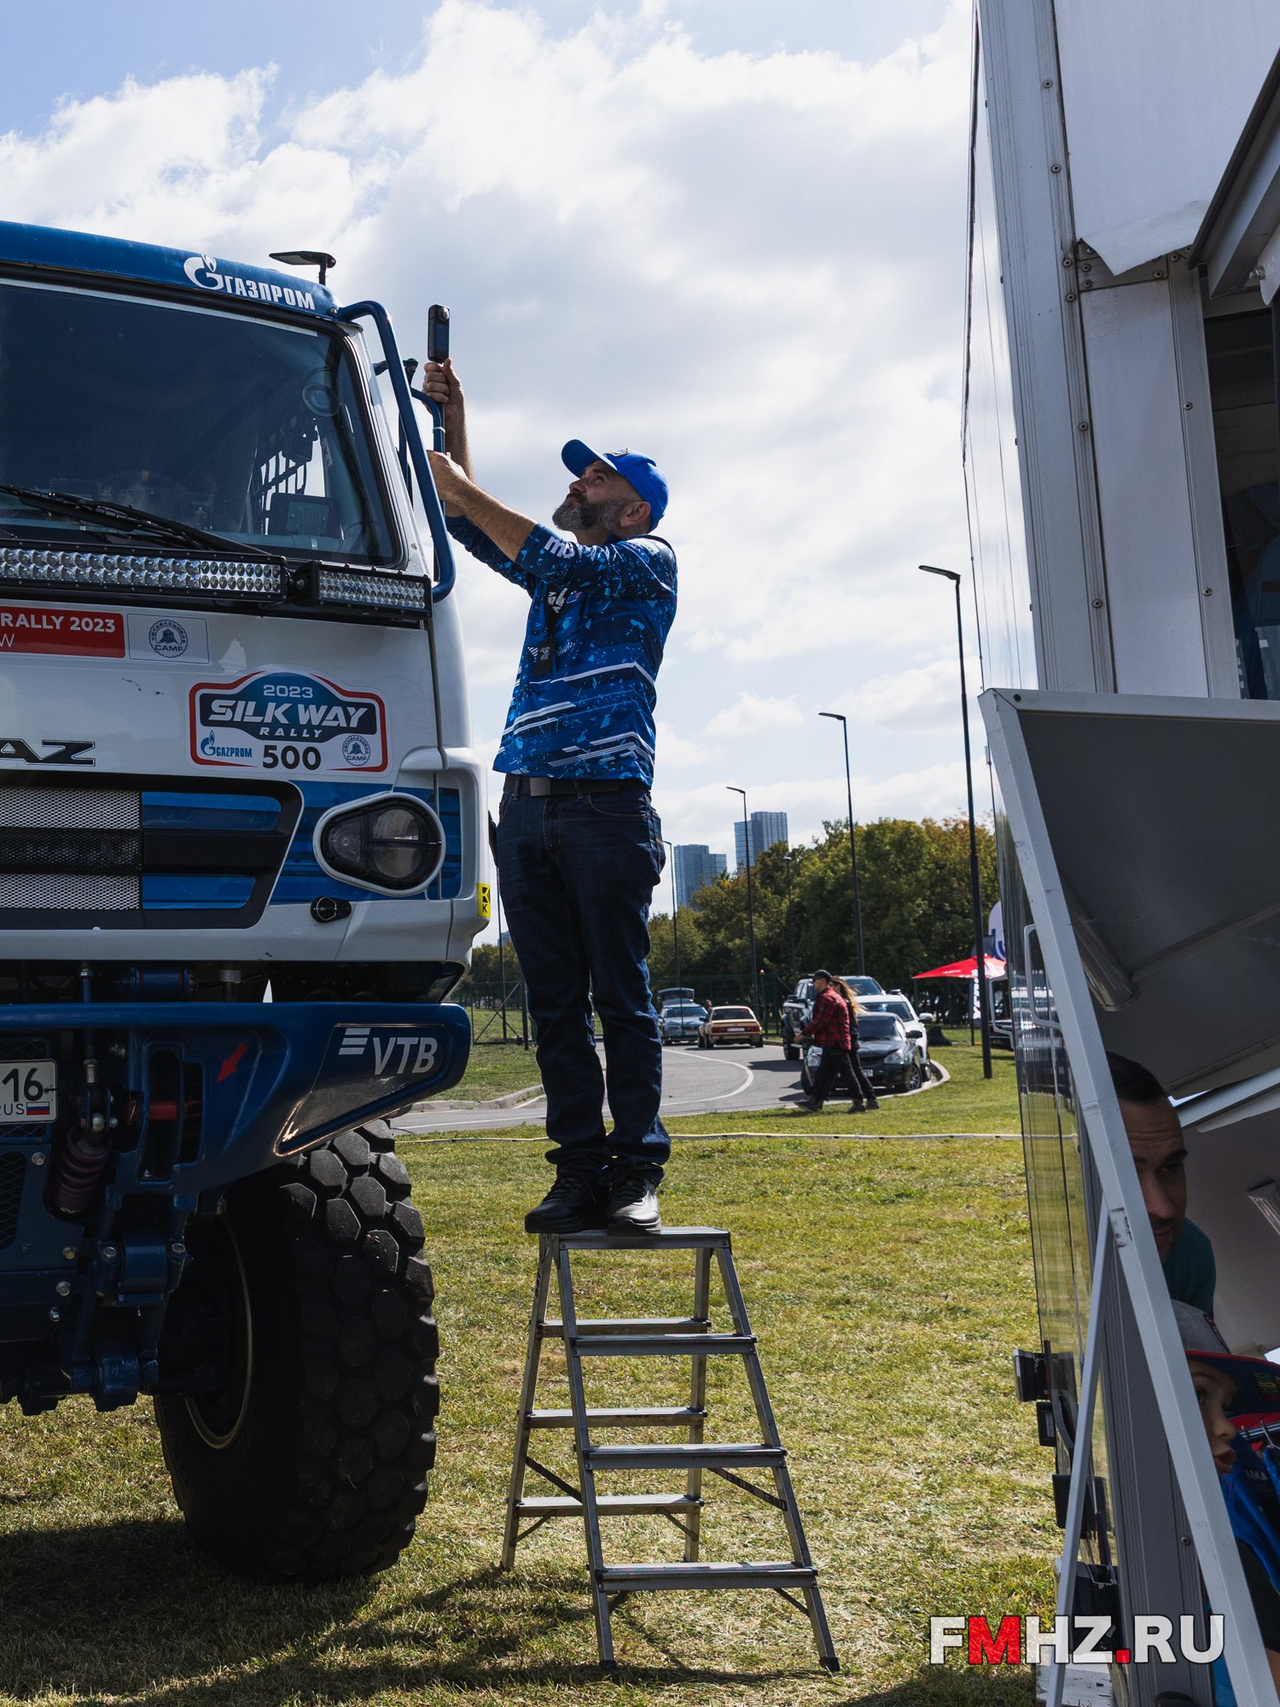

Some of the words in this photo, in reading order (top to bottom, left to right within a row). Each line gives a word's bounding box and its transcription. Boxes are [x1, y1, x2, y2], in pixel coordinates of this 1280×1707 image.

[224, 275, 316, 311] ГАЗПРОМ
[0, 612, 65, 631] RALLY
[69, 616, 116, 633] 2023
[263, 684, 313, 699] 2023
[208, 699, 294, 725] SILK
[297, 703, 369, 729] WAY
[259, 726, 323, 739] RALLY
[215, 746, 253, 758] GAZPROM
[262, 745, 322, 770] 500
[372, 1036, 439, 1076] VTB
